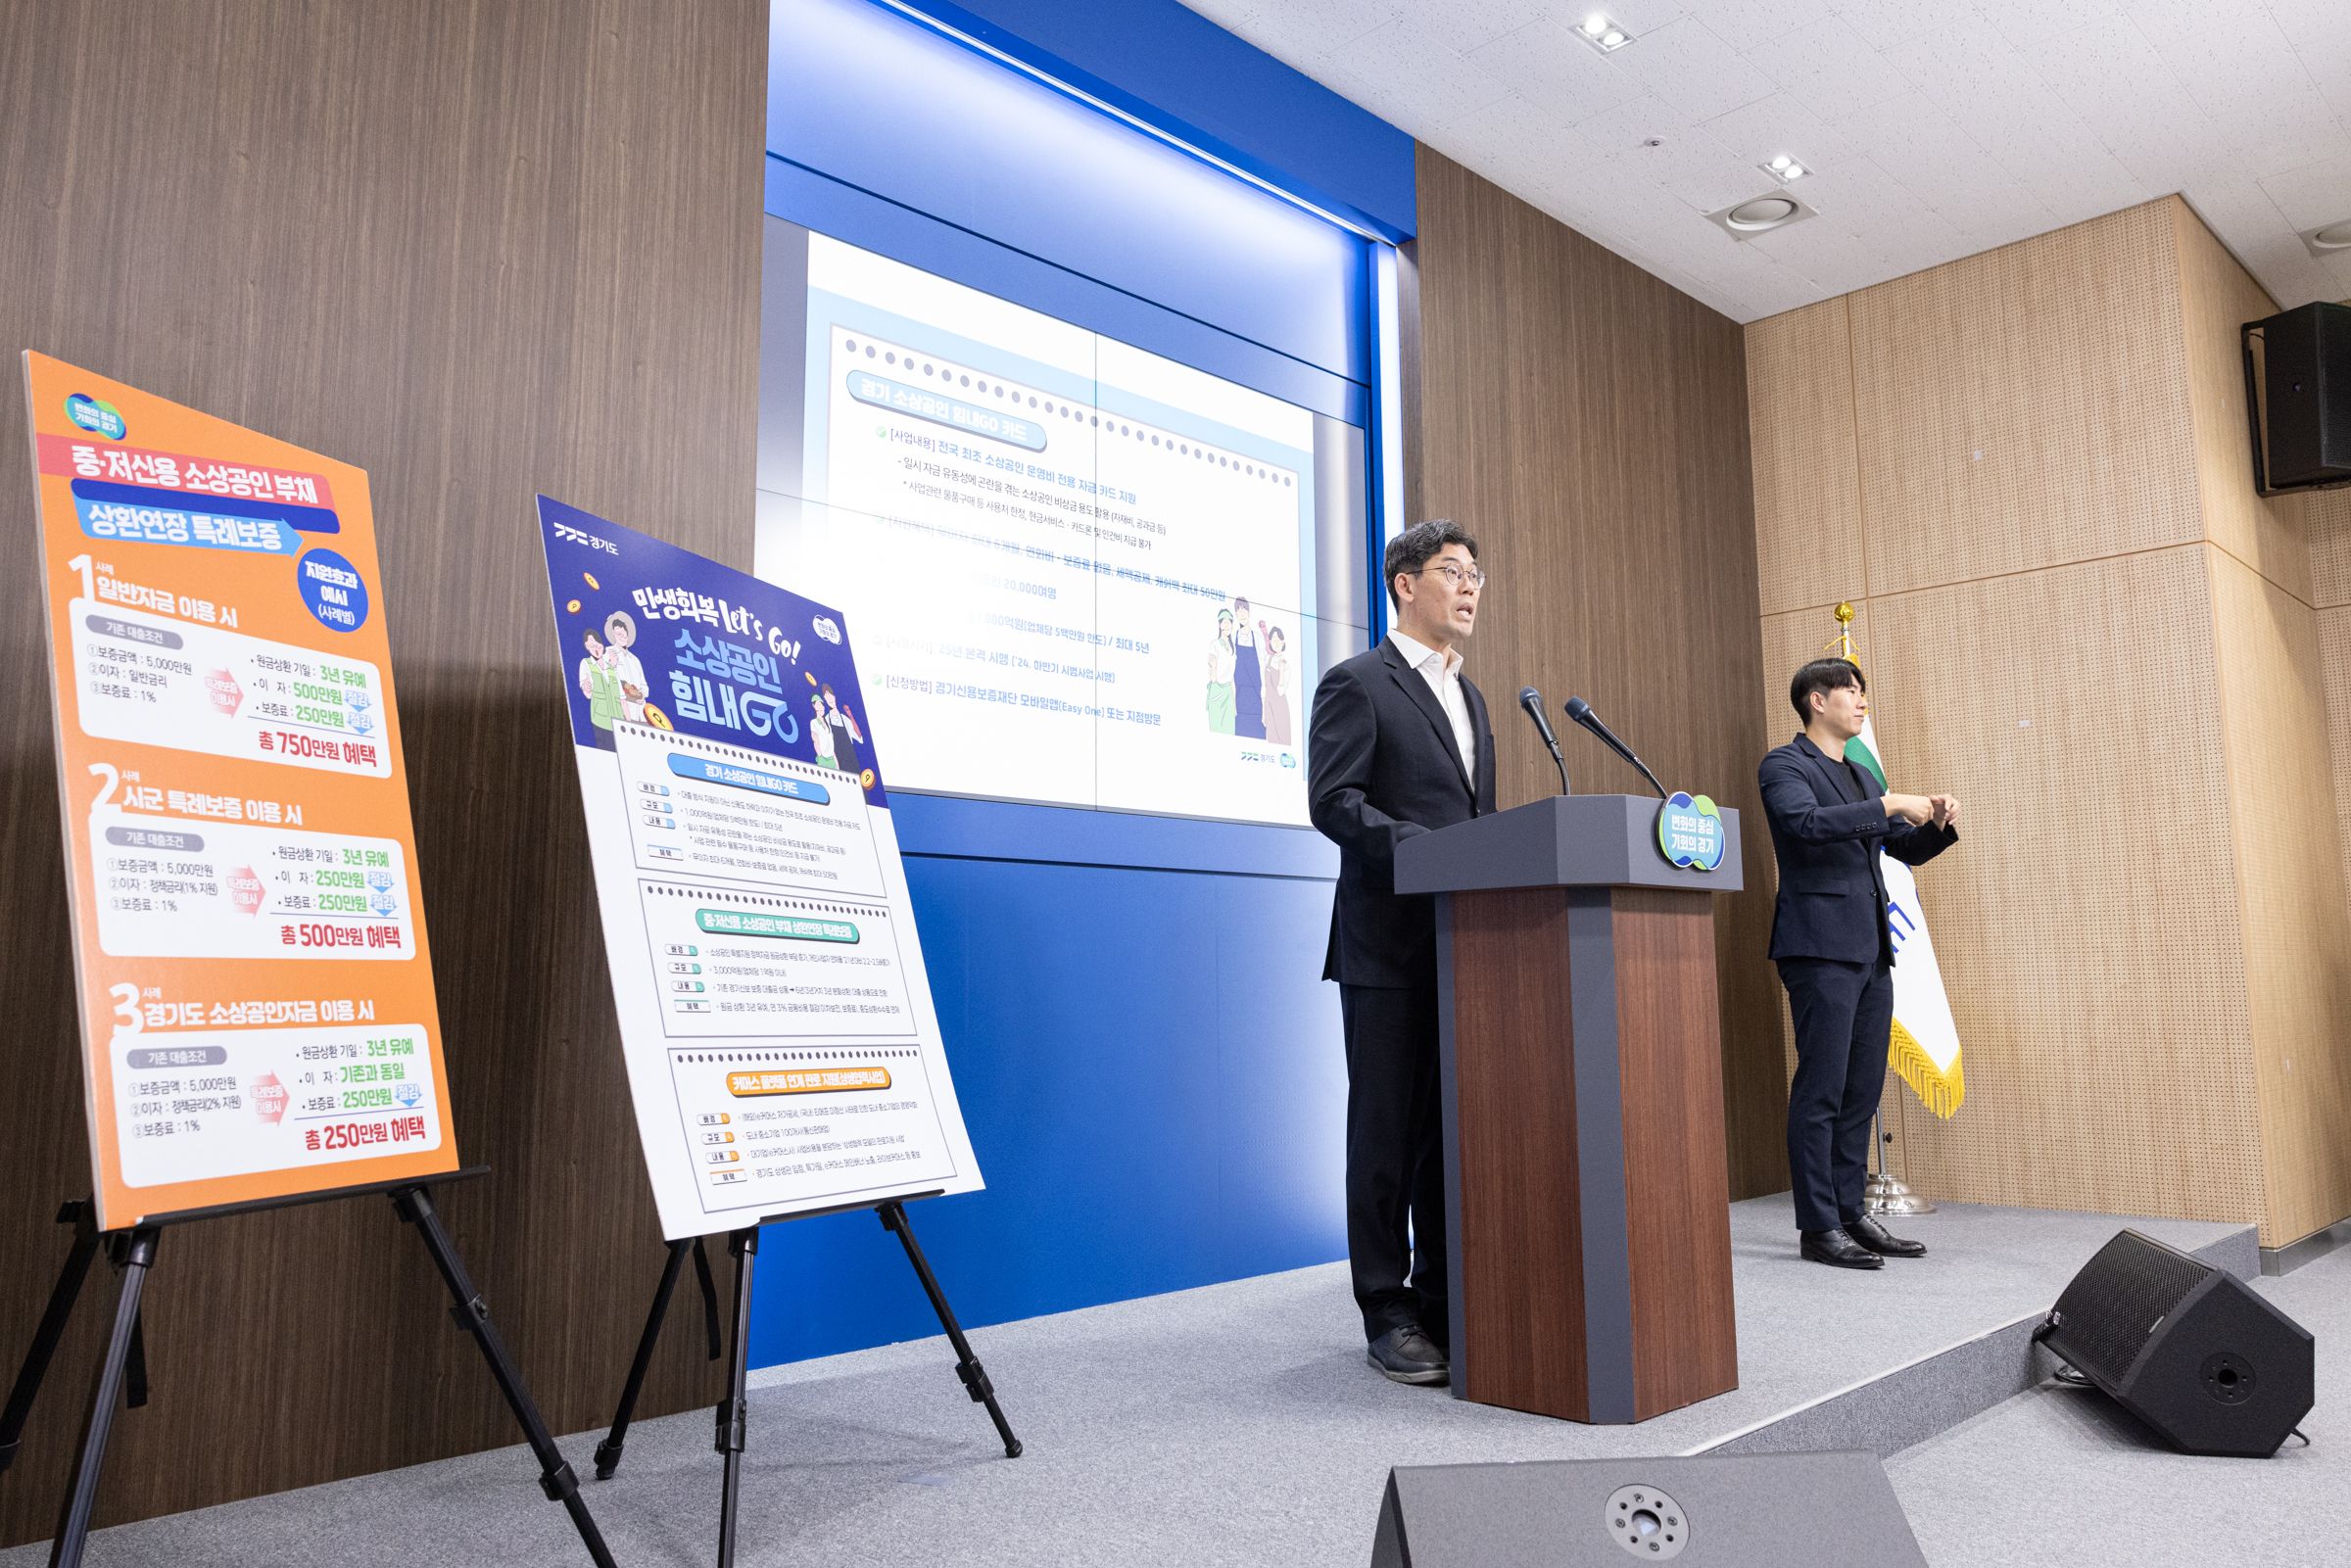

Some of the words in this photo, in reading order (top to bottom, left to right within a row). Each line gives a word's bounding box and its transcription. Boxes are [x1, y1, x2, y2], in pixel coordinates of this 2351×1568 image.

[861, 378, 889, 403] 경기
[893, 387, 949, 420] 소상공인
[952, 404, 998, 433] 힘내GO
[1002, 419, 1027, 441] 카드
[889, 427, 936, 452] [사업내용]
[938, 440, 958, 457] 전국
[961, 446, 982, 463] 최초
[984, 452, 1024, 475] 소상공인
[1027, 463, 1054, 483] 운영비
[1057, 472, 1075, 489] 전용
[1078, 478, 1096, 495] 자금
[1099, 484, 1116, 499] 카드
[1119, 489, 1135, 505] 지원
[185, 463, 272, 499] 소상공인
[274, 475, 318, 504] 부채
[903, 456, 921, 473] 일시
[923, 461, 940, 477] 자금
[942, 465, 977, 486] 유동성에
[978, 475, 1002, 493] 곤란을
[1004, 482, 1020, 498] 겪는
[1022, 487, 1052, 506] 소상공인
[1054, 496, 1077, 512] 비상금
[1078, 501, 1092, 516] 용도
[908, 480, 941, 499] 사업관련
[977, 497, 984, 509] 등
[985, 499, 1009, 515] 사용처
[88, 503, 189, 543] 상환연장
[193, 514, 282, 550] 특례보증
[589, 534, 619, 557] 경기도
[66, 549, 95, 601] 1
[305, 559, 358, 591] 지원효과
[1003, 578, 1056, 599] 20,000여명
[96, 575, 175, 615] 일반자금
[177, 594, 216, 624] 이용
[217, 604, 238, 629] 시
[319, 583, 348, 607] 예시
[316, 602, 356, 627] (사례별)
[633, 587, 719, 627] 민생회복
[719, 599, 764, 642] Let's
[769, 627, 801, 665] Go!
[1115, 637, 1132, 650] 최대
[1135, 641, 1149, 653] 5년
[145, 654, 192, 676] 5,000만원
[255, 652, 291, 674] 원금상환
[318, 665, 341, 684] 3년
[341, 669, 366, 689] 유예
[674, 628, 783, 694] 소상공인
[988, 650, 1008, 666] 시행
[1033, 658, 1059, 674] 하반기
[1061, 663, 1093, 679] 시범사업
[127, 668, 168, 689] 일반금리
[140, 689, 157, 704] 1%
[292, 681, 342, 706] 500만원
[885, 674, 933, 693] [신청방법]
[935, 681, 1018, 705] 경기신용보증재단
[1106, 707, 1124, 721] 또는
[1126, 710, 1161, 726] 지점방문
[262, 700, 288, 718] 보증료
[295, 704, 345, 729] 250만원
[258, 730, 273, 750] 총
[276, 731, 340, 762] 750만원
[342, 740, 377, 768] 혜택
[87, 761, 121, 813] 2
[121, 784, 164, 811] 시군
[167, 789, 243, 819] 특례보증
[245, 799, 282, 824] 이용
[283, 803, 303, 827] 시
[1671, 814, 1696, 832] 변화의
[1698, 816, 1714, 834] 중심
[277, 844, 313, 862] 원금상환
[341, 848, 363, 866] 3년
[363, 850, 389, 868] 유예
[1671, 833, 1697, 851] 기회의
[1698, 835, 1714, 854] 경기
[167, 861, 214, 878] 5,000만원
[313, 869, 365, 888] 250만원
[161, 898, 177, 913] 1%
[283, 894, 311, 910] 보증료
[316, 893, 367, 912] 250만원
[280, 926, 296, 946] 총
[299, 924, 363, 948] 500만원
[365, 925, 401, 949] 혜택
[108, 982, 144, 1036] 3
[144, 1001, 205, 1027] 경기도
[208, 998, 317, 1027] 소상공인자금
[319, 998, 355, 1022] 이용
[356, 999, 375, 1022] 시
[301, 1044, 338, 1061] 원금상환
[365, 1038, 388, 1058] 3년
[388, 1037, 414, 1056] 유예
[188, 1074, 236, 1093] 5,000만원
[339, 1063, 378, 1085] 기존과
[378, 1062, 405, 1081] 동일
[308, 1095, 335, 1113] 보증료
[342, 1086, 393, 1111] 250만원
[183, 1117, 201, 1133] 1%
[305, 1129, 320, 1152] 총
[322, 1117, 388, 1153] 250만원
[390, 1114, 425, 1143] 혜택
